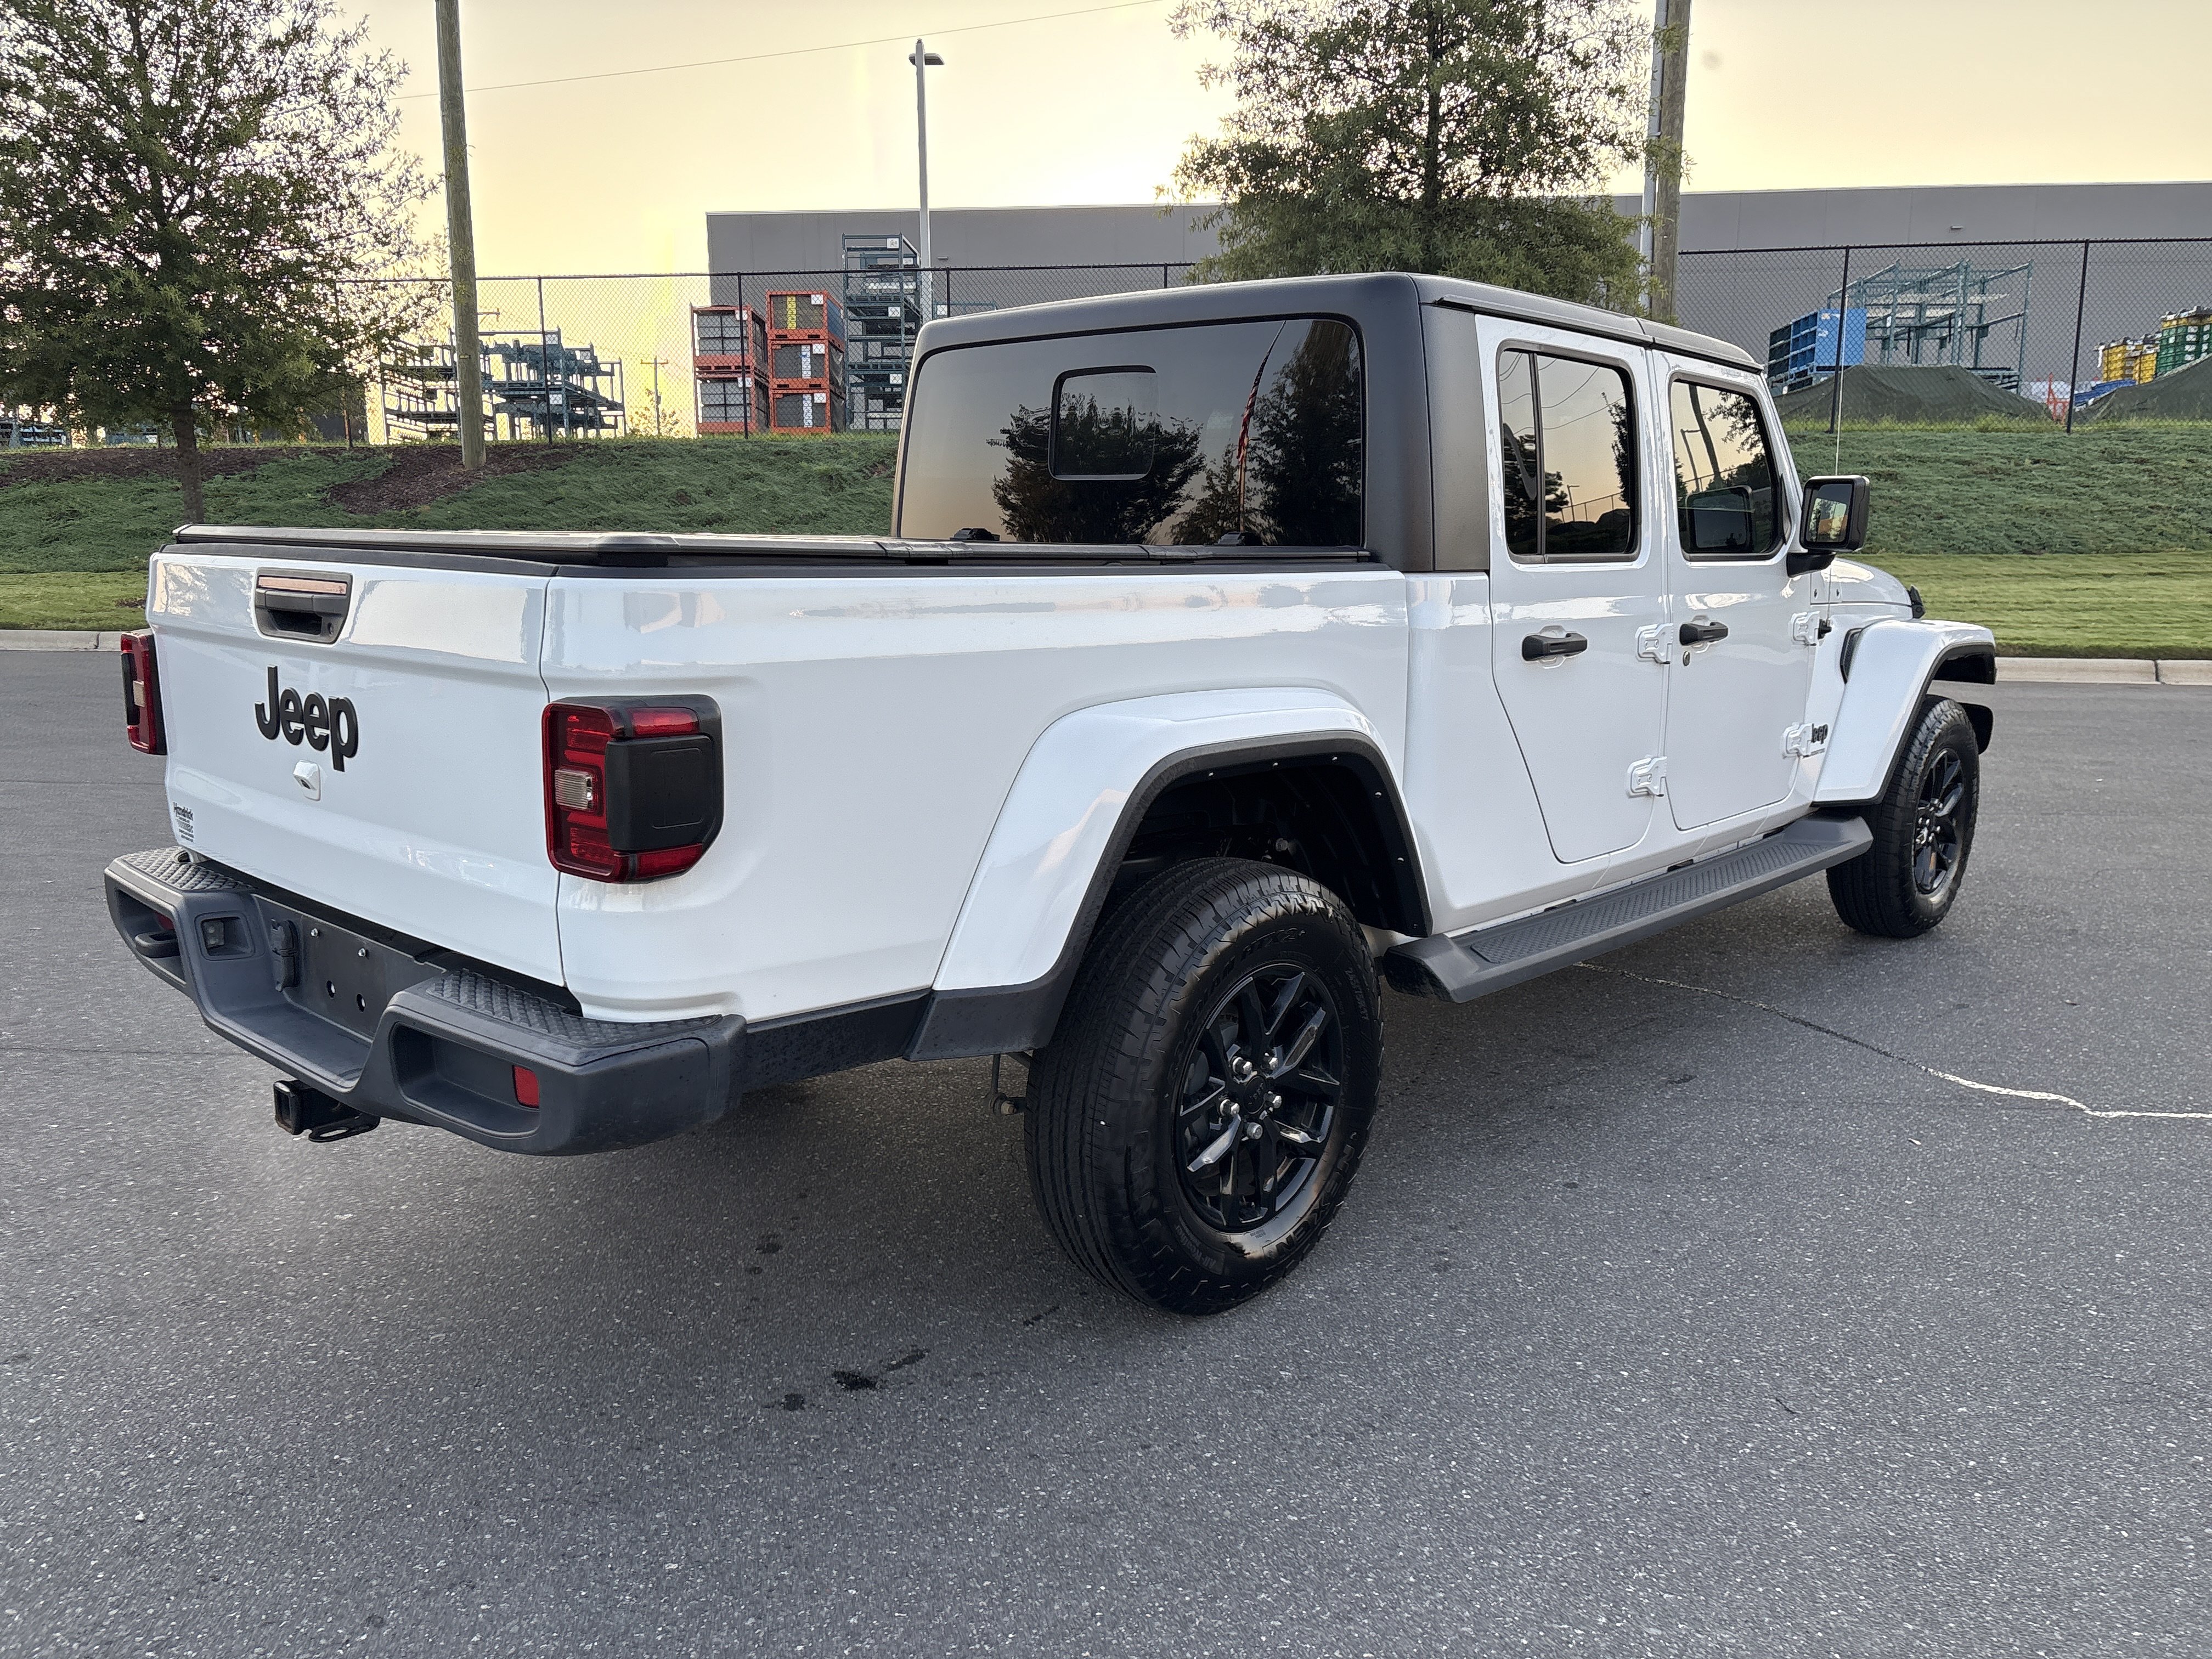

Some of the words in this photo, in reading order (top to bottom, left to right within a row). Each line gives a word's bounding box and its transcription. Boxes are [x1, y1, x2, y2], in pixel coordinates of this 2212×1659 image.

[254, 664, 359, 772] Jeep
[1811, 723, 1829, 744] Jeep
[1275, 1143, 1354, 1261] NEXEN
